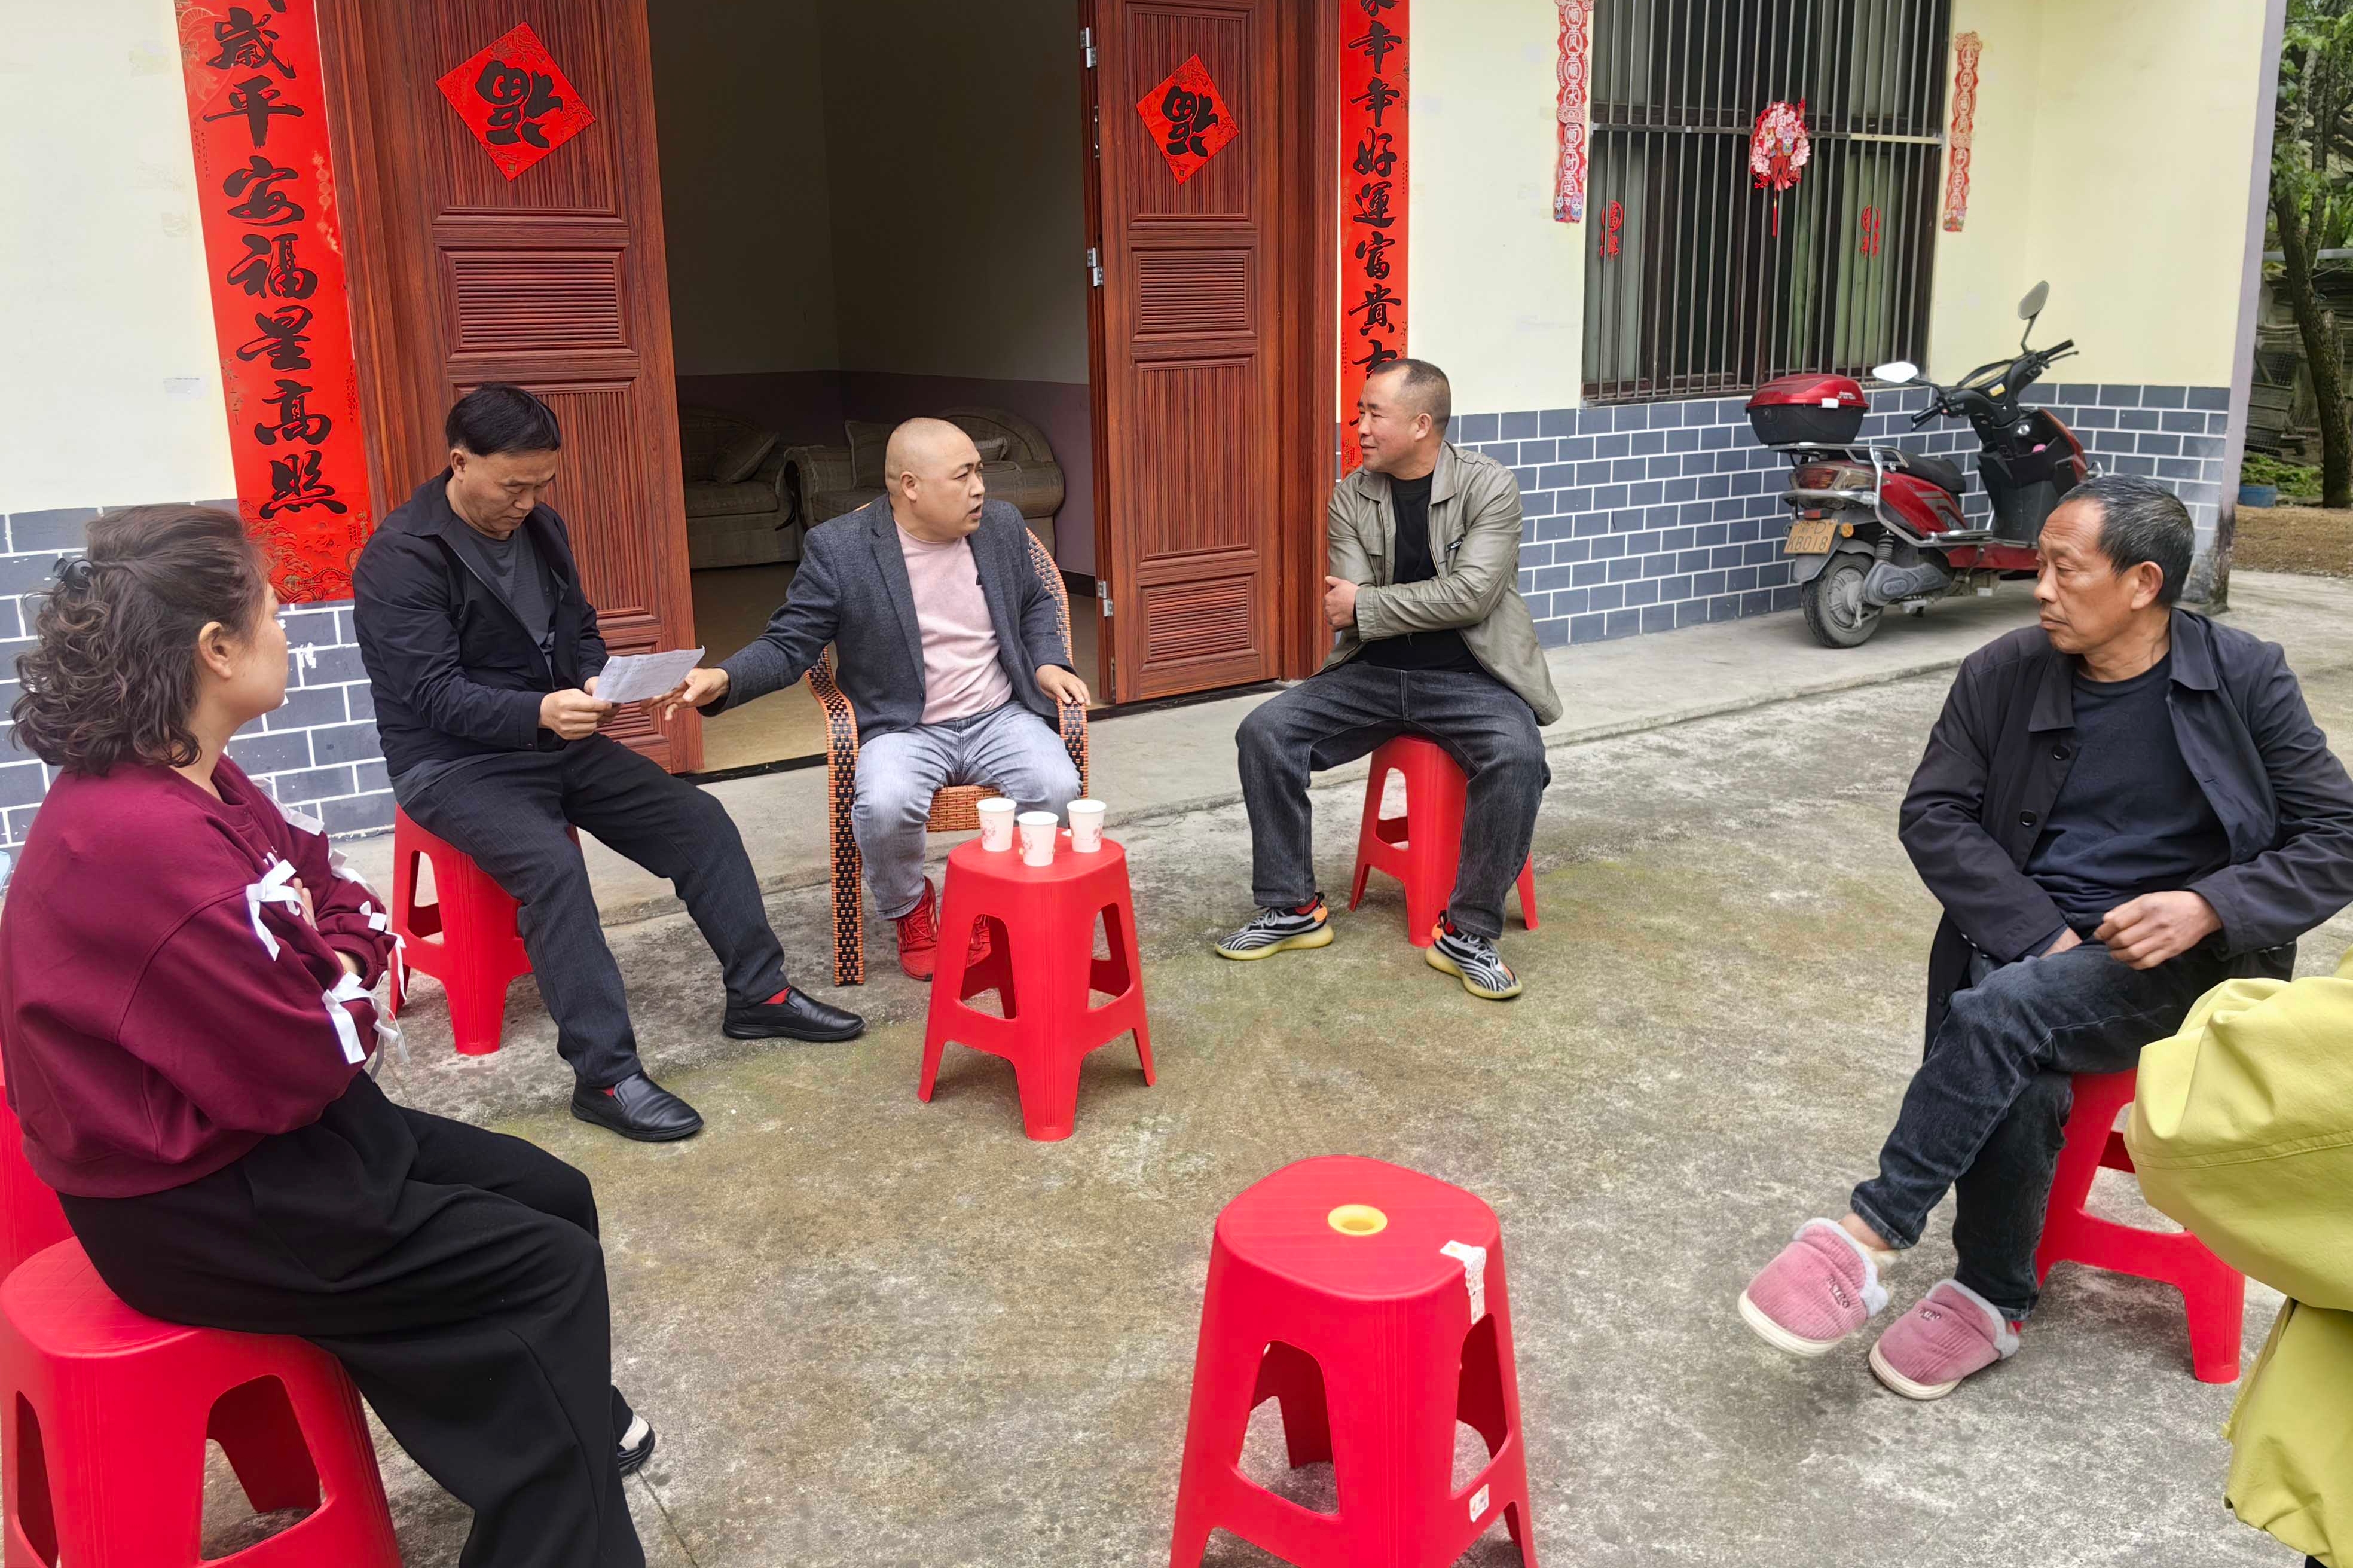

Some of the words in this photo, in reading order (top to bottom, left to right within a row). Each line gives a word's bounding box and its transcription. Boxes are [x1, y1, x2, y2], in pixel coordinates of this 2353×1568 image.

[475, 60, 563, 148] 福
[1161, 85, 1218, 157] 福
[1562, 6, 1581, 196] 顺风顺水顺财运
[203, 0, 347, 519] 歲平安福星高照
[1348, 0, 1402, 426] 年年好運富貴
